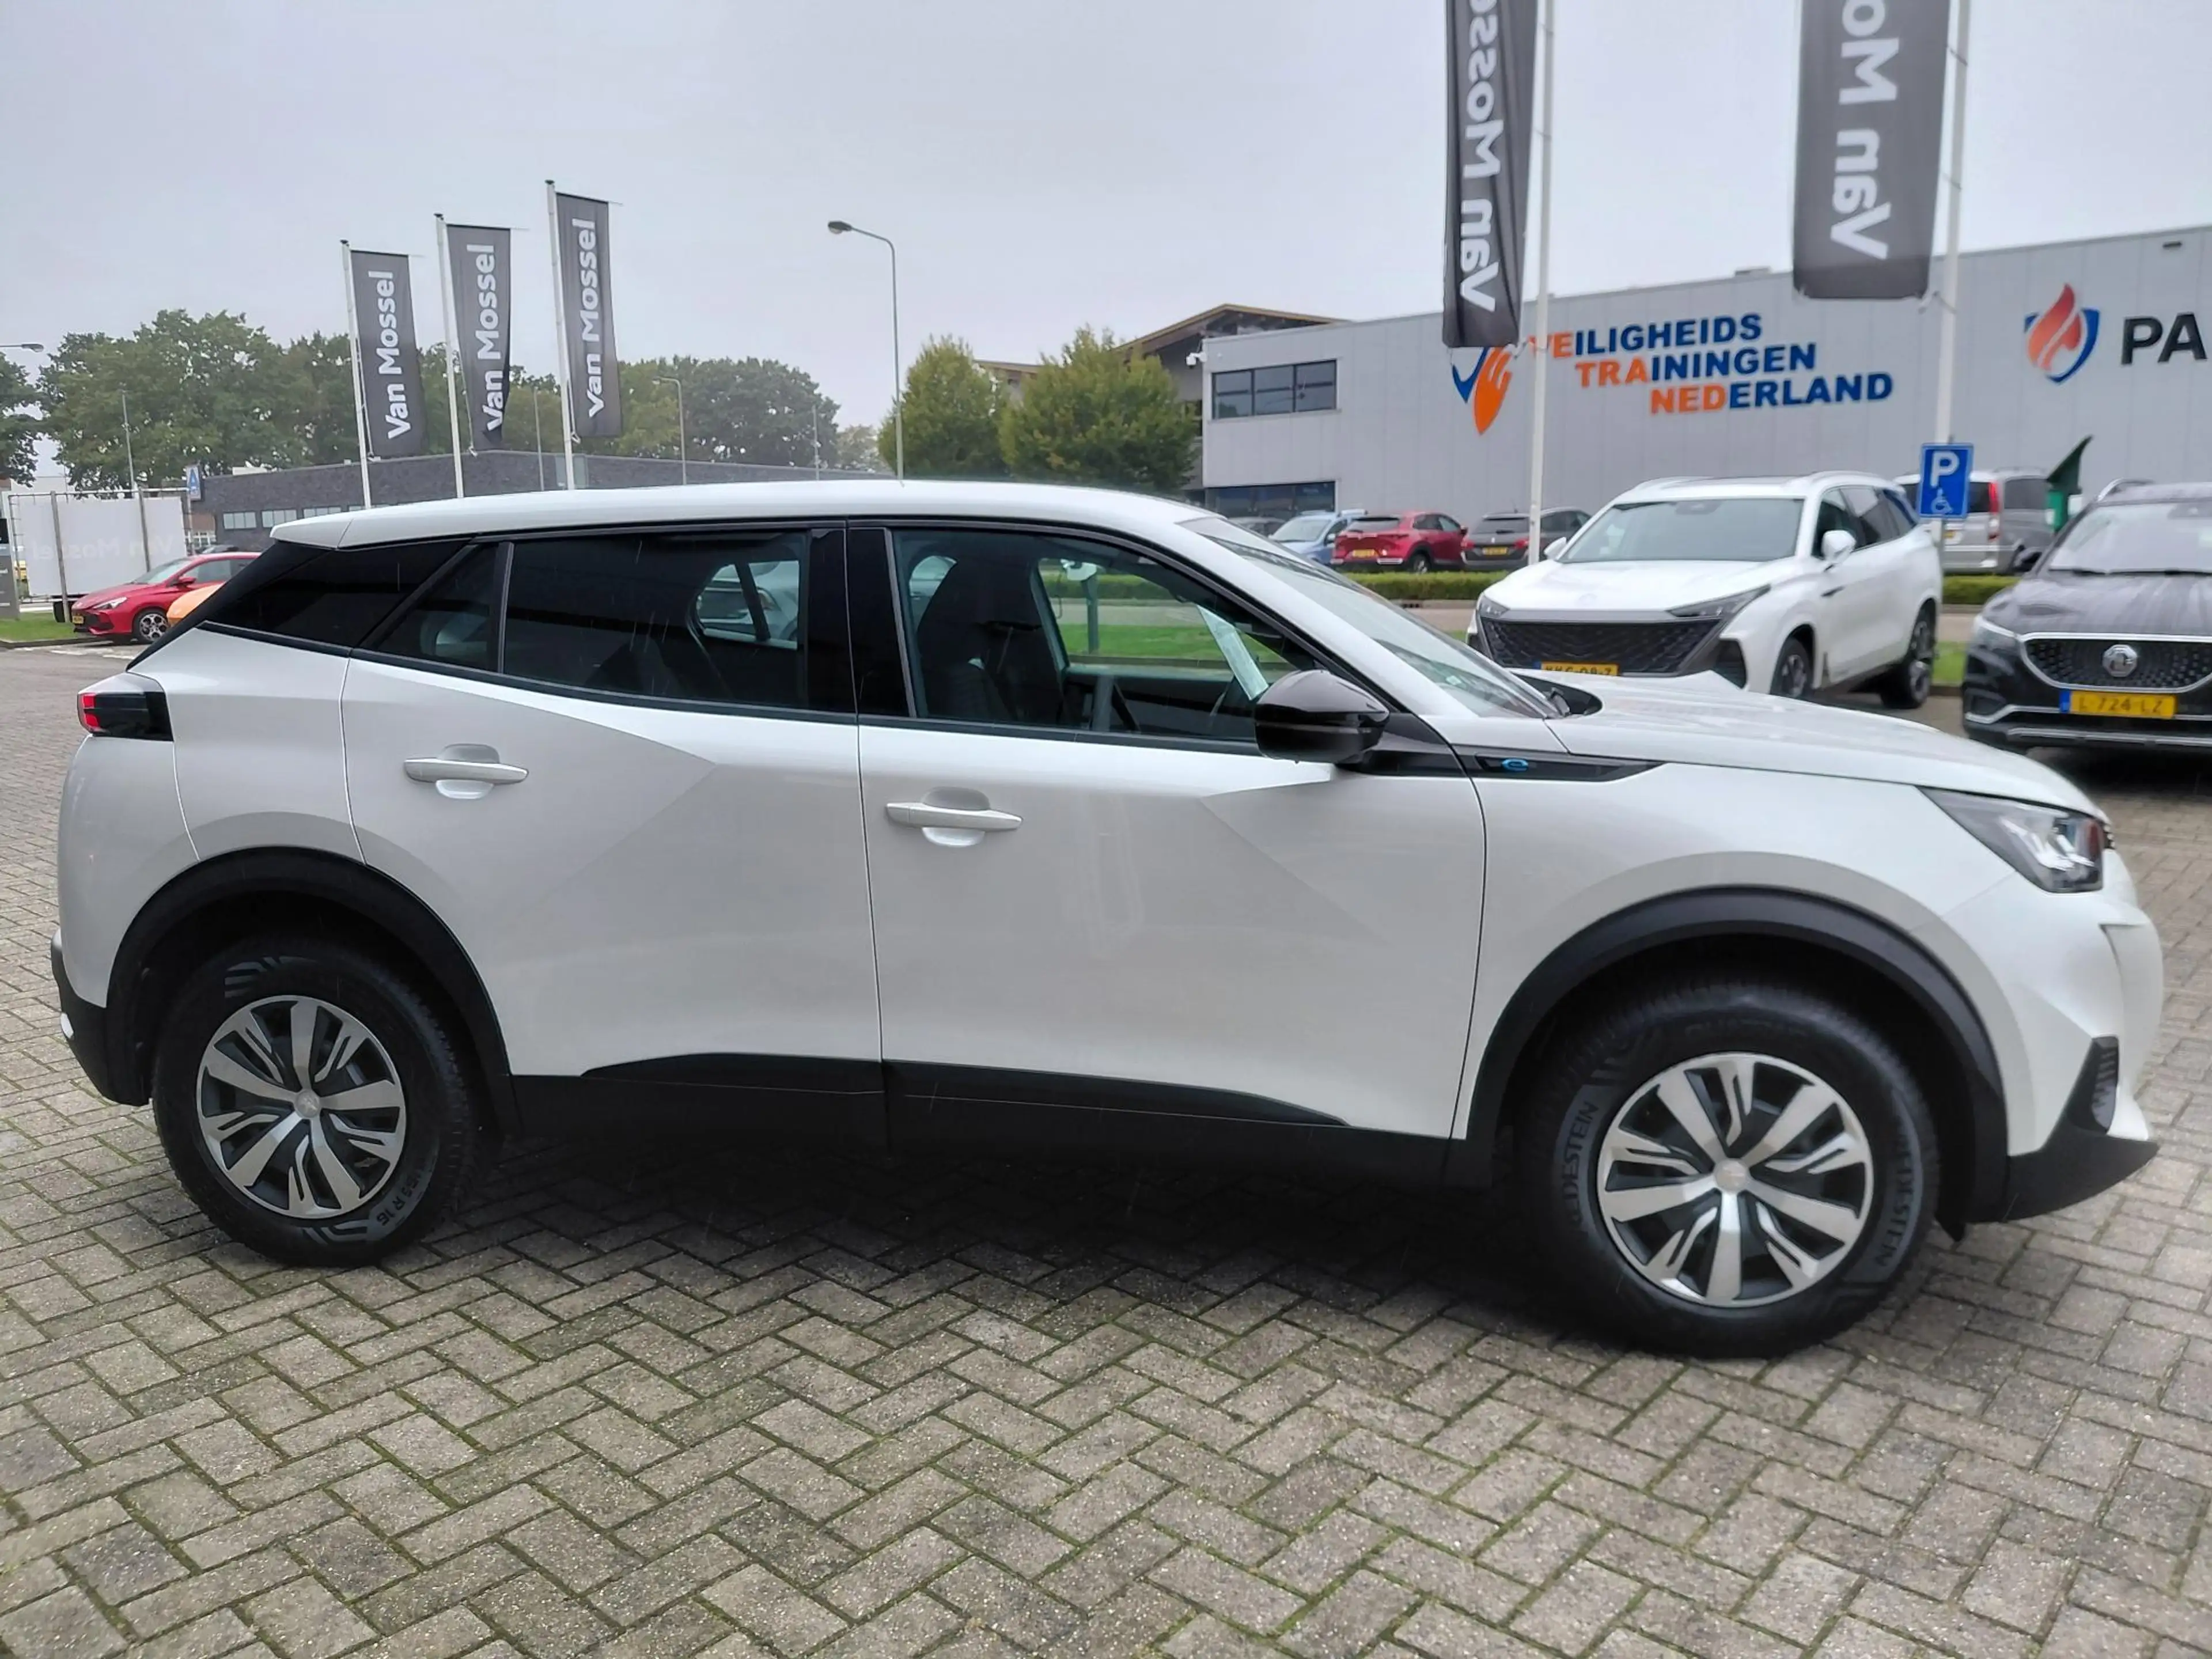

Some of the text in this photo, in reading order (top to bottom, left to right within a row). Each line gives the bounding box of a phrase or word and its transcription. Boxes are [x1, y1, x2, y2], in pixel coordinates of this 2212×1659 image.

[467, 244, 503, 431] Van Mossel
[572, 218, 605, 418] Van Mossel
[2121, 312, 2208, 365] PA
[368, 271, 411, 440] Van Mossel
[1575, 343, 1817, 388] TRAININGEN
[1650, 373, 1893, 415] NEDERLAND
[1930, 451, 1960, 487] P
